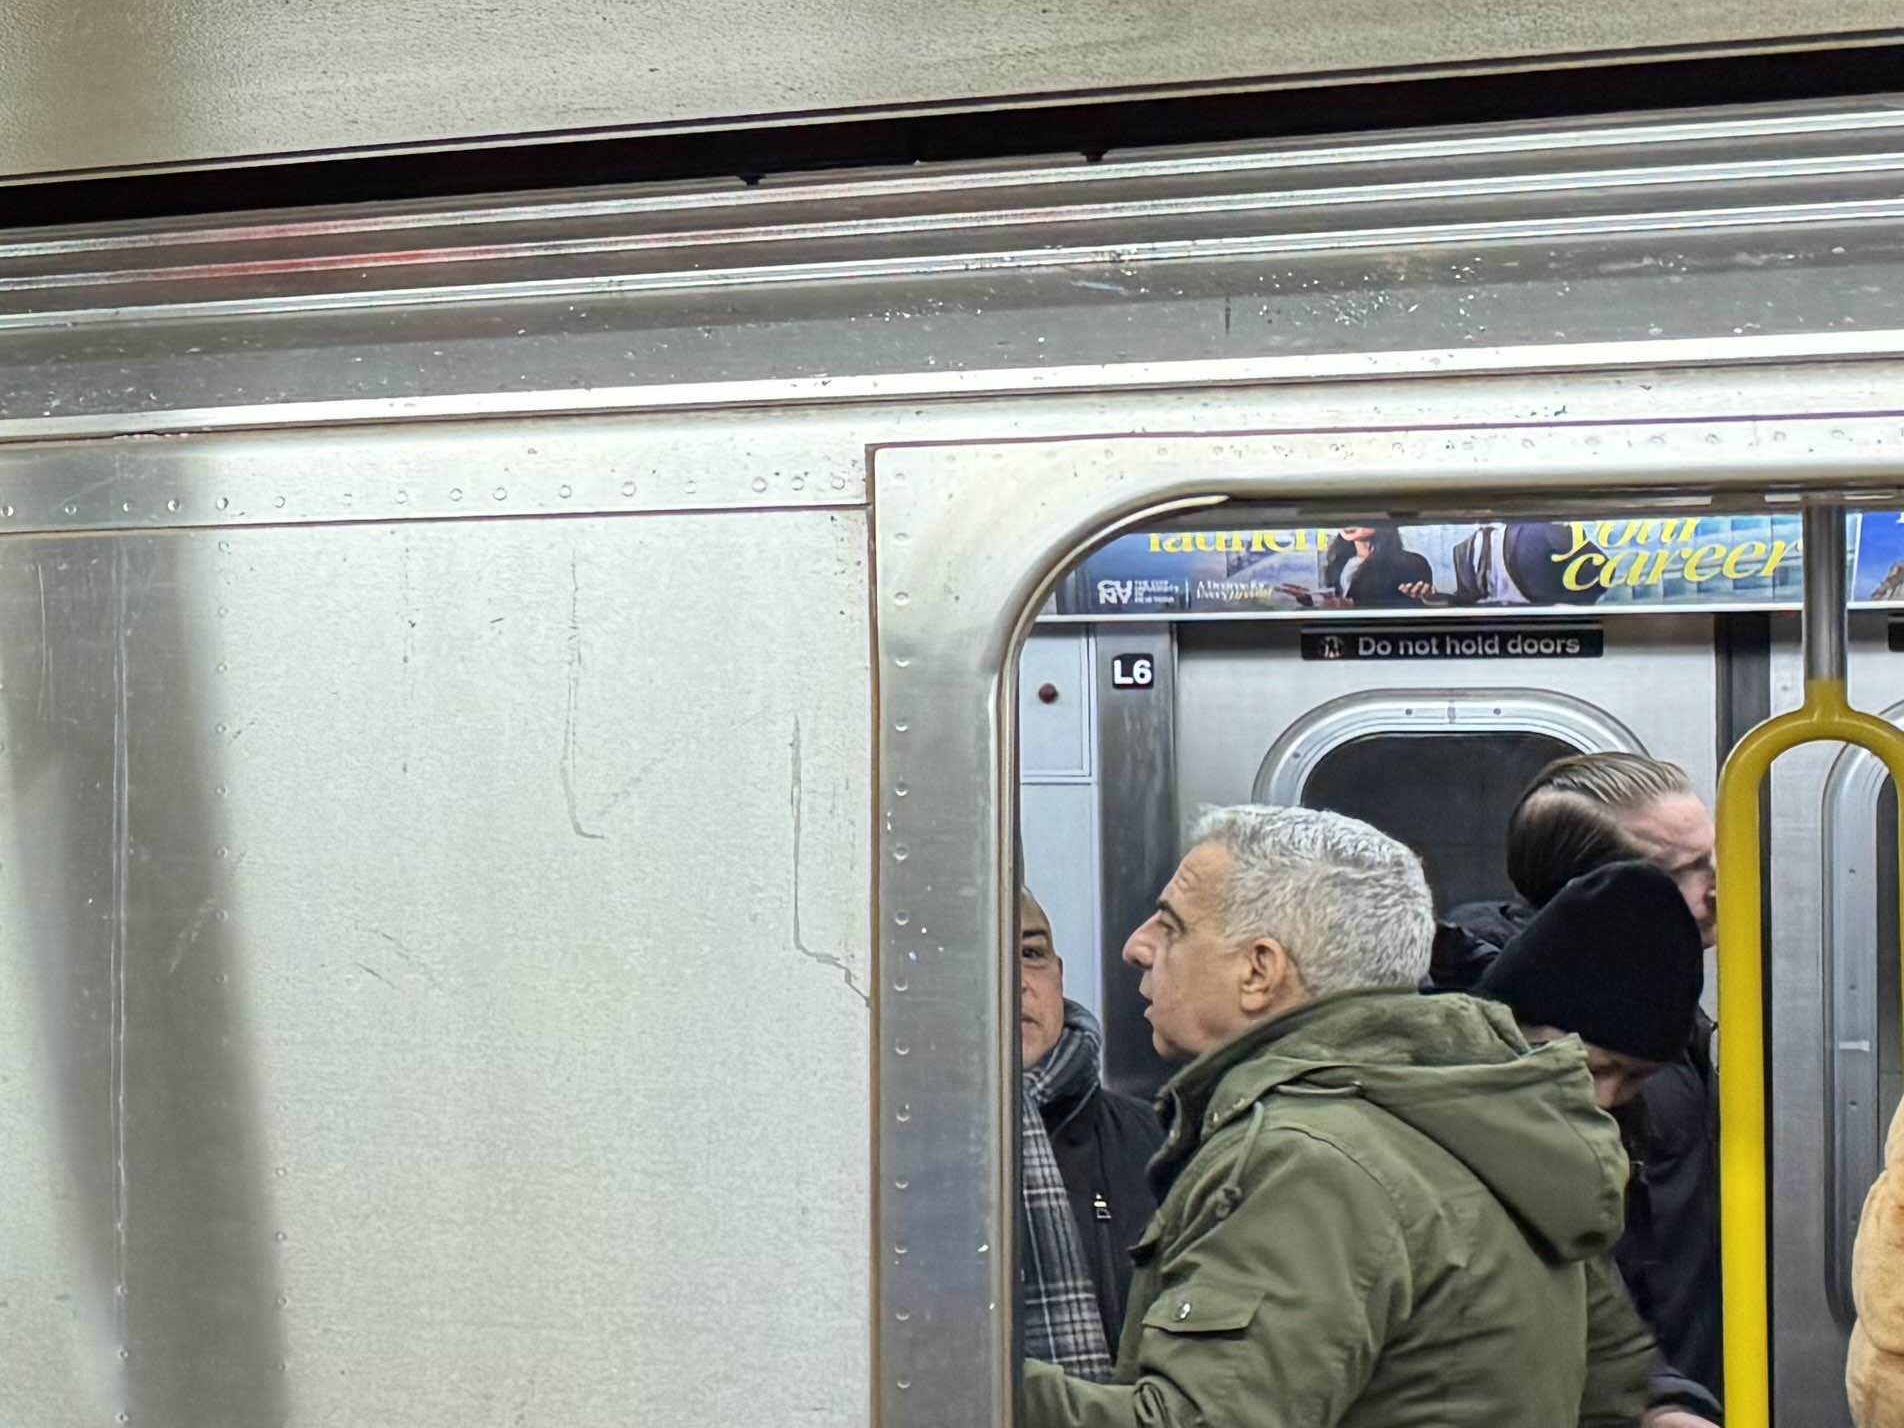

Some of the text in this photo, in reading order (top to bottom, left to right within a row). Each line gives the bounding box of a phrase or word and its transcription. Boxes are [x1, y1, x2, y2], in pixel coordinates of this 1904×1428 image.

[1562, 538, 1805, 591] career
[1358, 634, 1580, 656] Do not hold doors
[1114, 659, 1152, 684] L6
